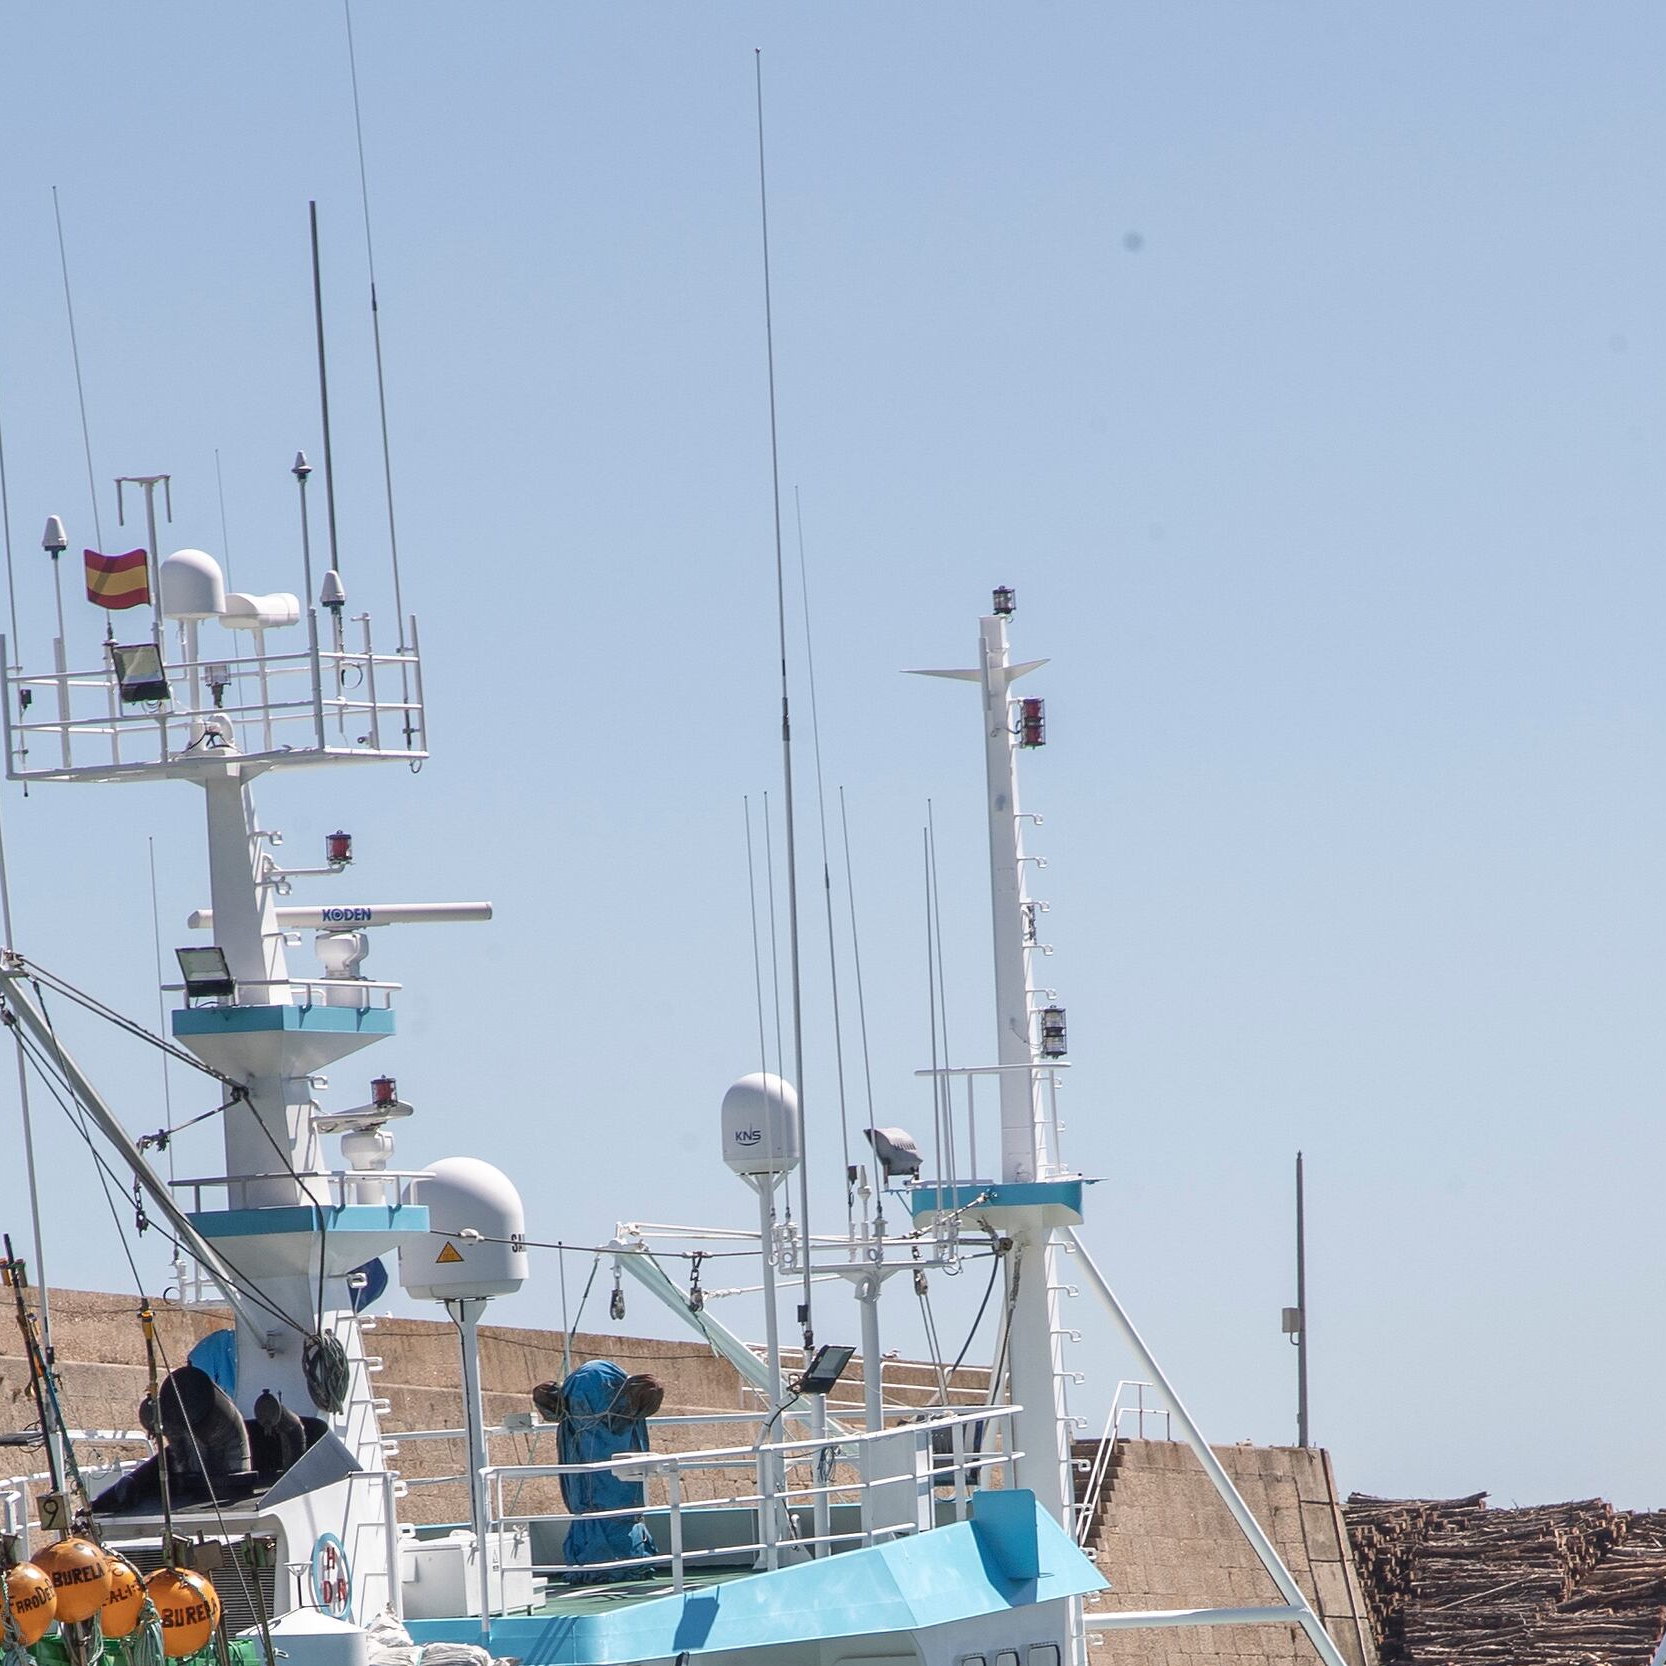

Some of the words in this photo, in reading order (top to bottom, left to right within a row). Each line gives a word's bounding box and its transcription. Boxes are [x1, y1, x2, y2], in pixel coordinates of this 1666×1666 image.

[322, 907, 371, 921] KODEN
[735, 1128, 762, 1141] KNS
[42, 1499, 60, 1529] 9
[52, 1561, 104, 1588] BURELA
